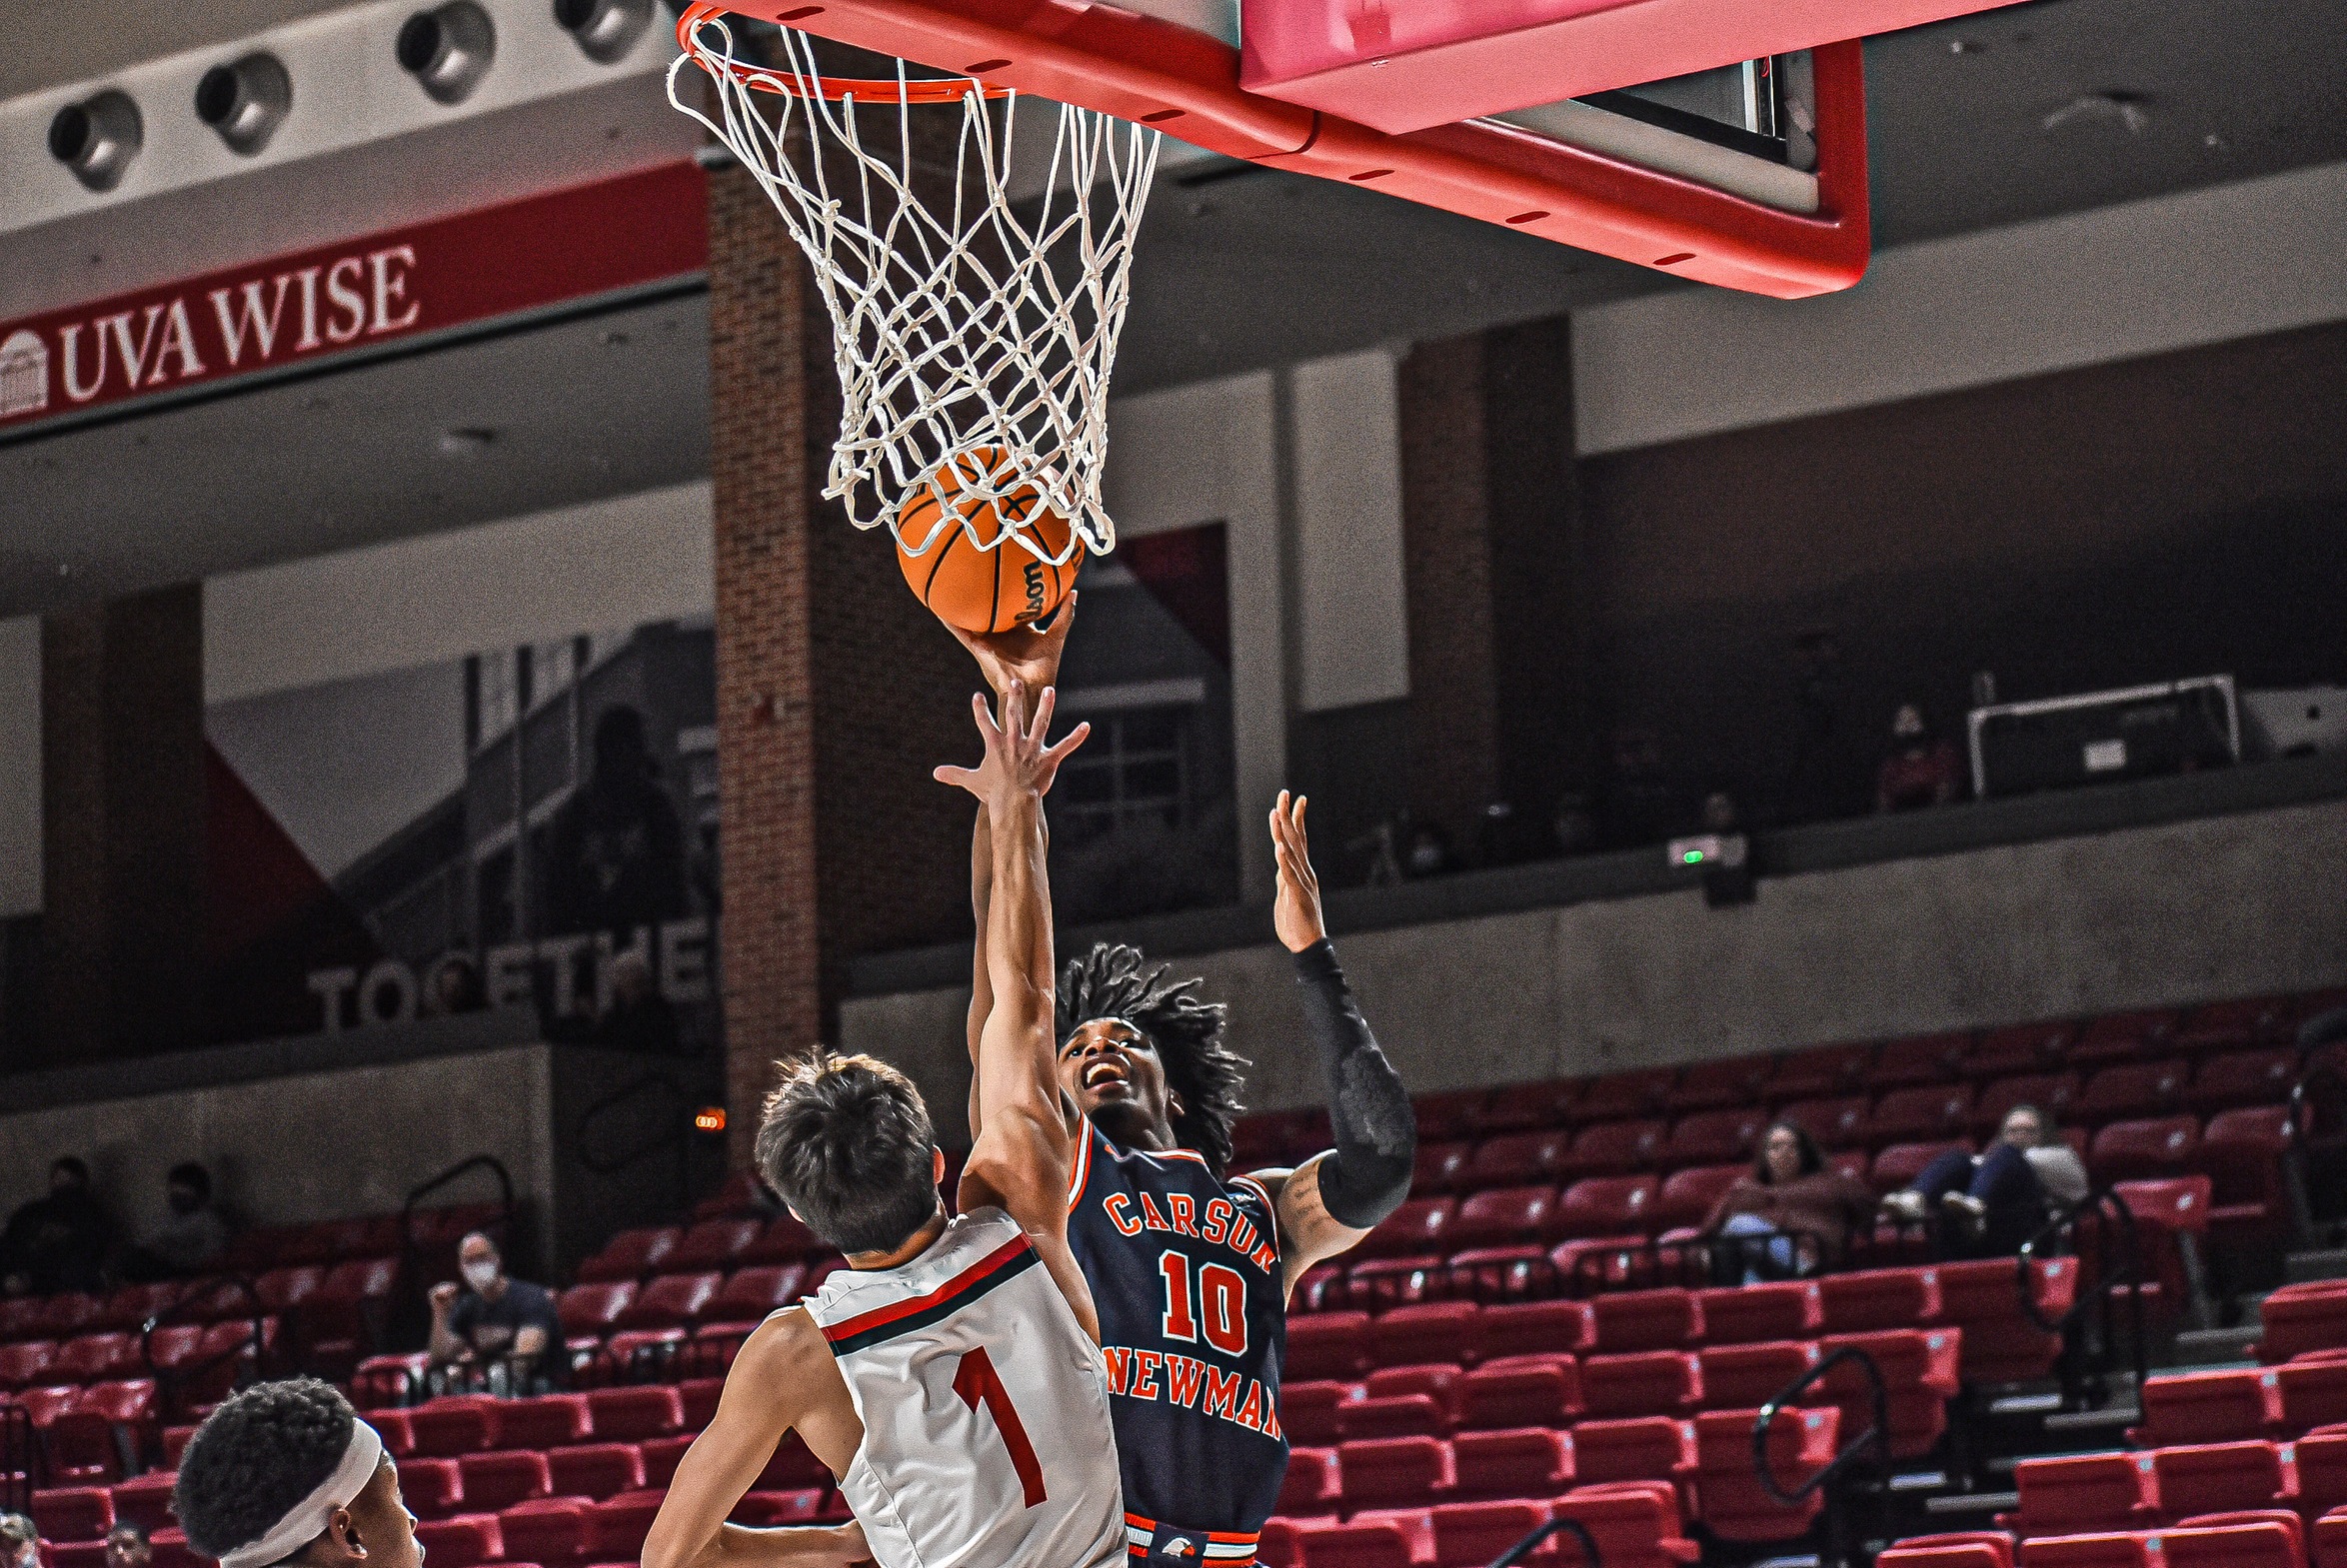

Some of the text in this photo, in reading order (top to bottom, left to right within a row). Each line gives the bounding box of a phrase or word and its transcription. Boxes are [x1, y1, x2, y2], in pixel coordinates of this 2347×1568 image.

[58, 244, 421, 402] UVA WISE
[1014, 559, 1046, 623] lson
[1159, 1249, 1249, 1358] 10
[952, 1345, 1049, 1510] 1
